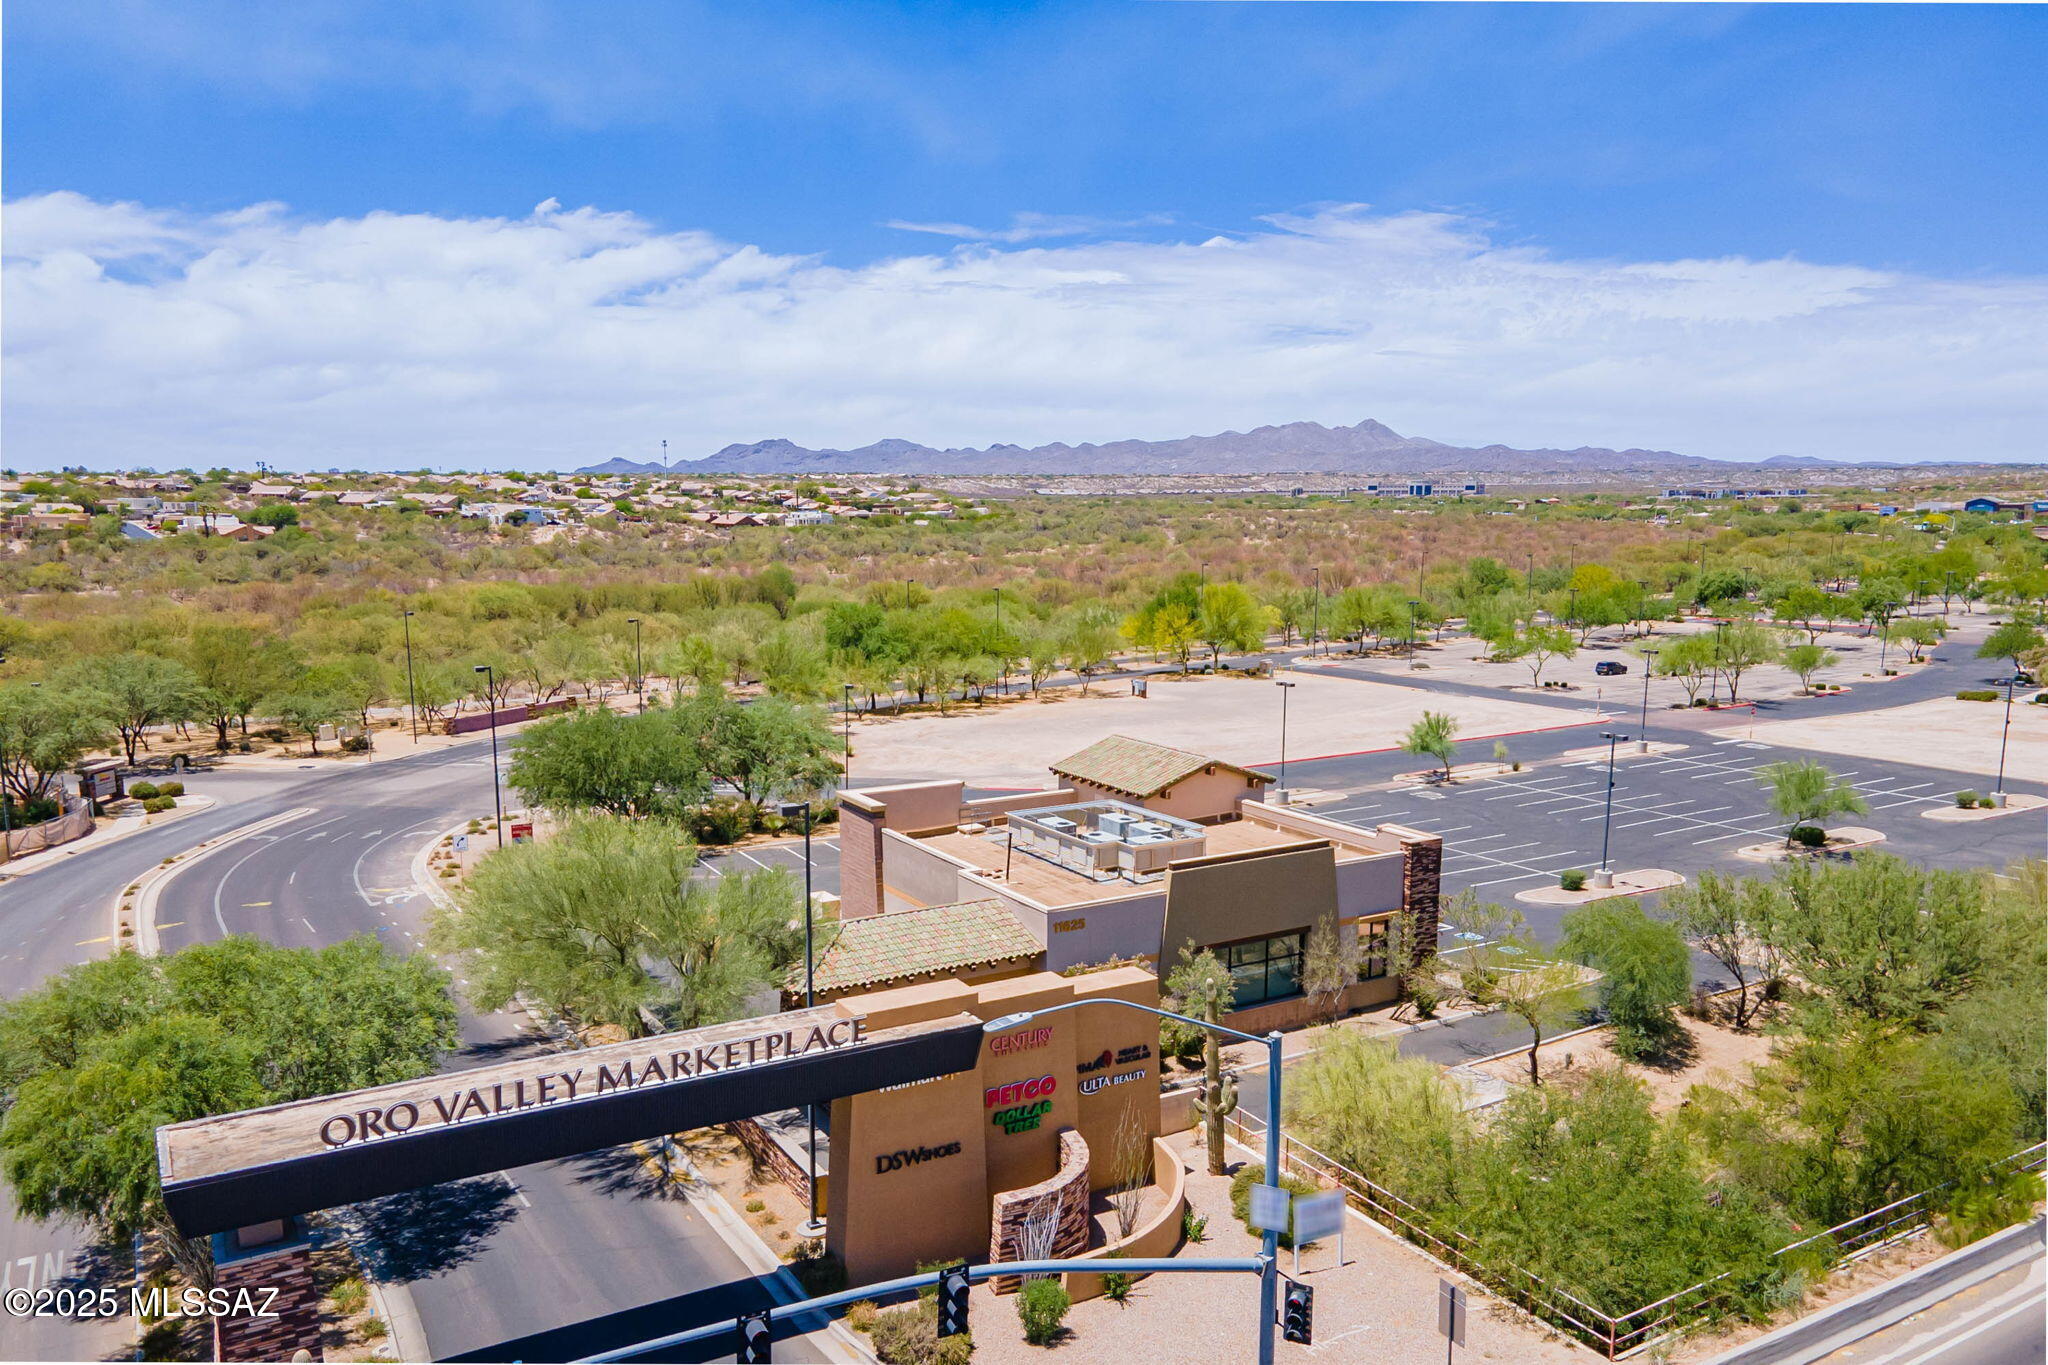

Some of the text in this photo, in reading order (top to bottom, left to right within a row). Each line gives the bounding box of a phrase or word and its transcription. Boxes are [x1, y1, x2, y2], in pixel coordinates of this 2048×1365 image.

[1053, 918, 1086, 934] 11625
[990, 1027, 1053, 1052] CENTURY
[319, 1014, 868, 1146] ORO VALLEY MARKETPLACE
[985, 1075, 1056, 1108] PETCO
[1080, 1069, 1146, 1094] ULTA BEAUTY
[993, 1100, 1053, 1125] DOLLAR
[1005, 1116, 1041, 1135] TREE
